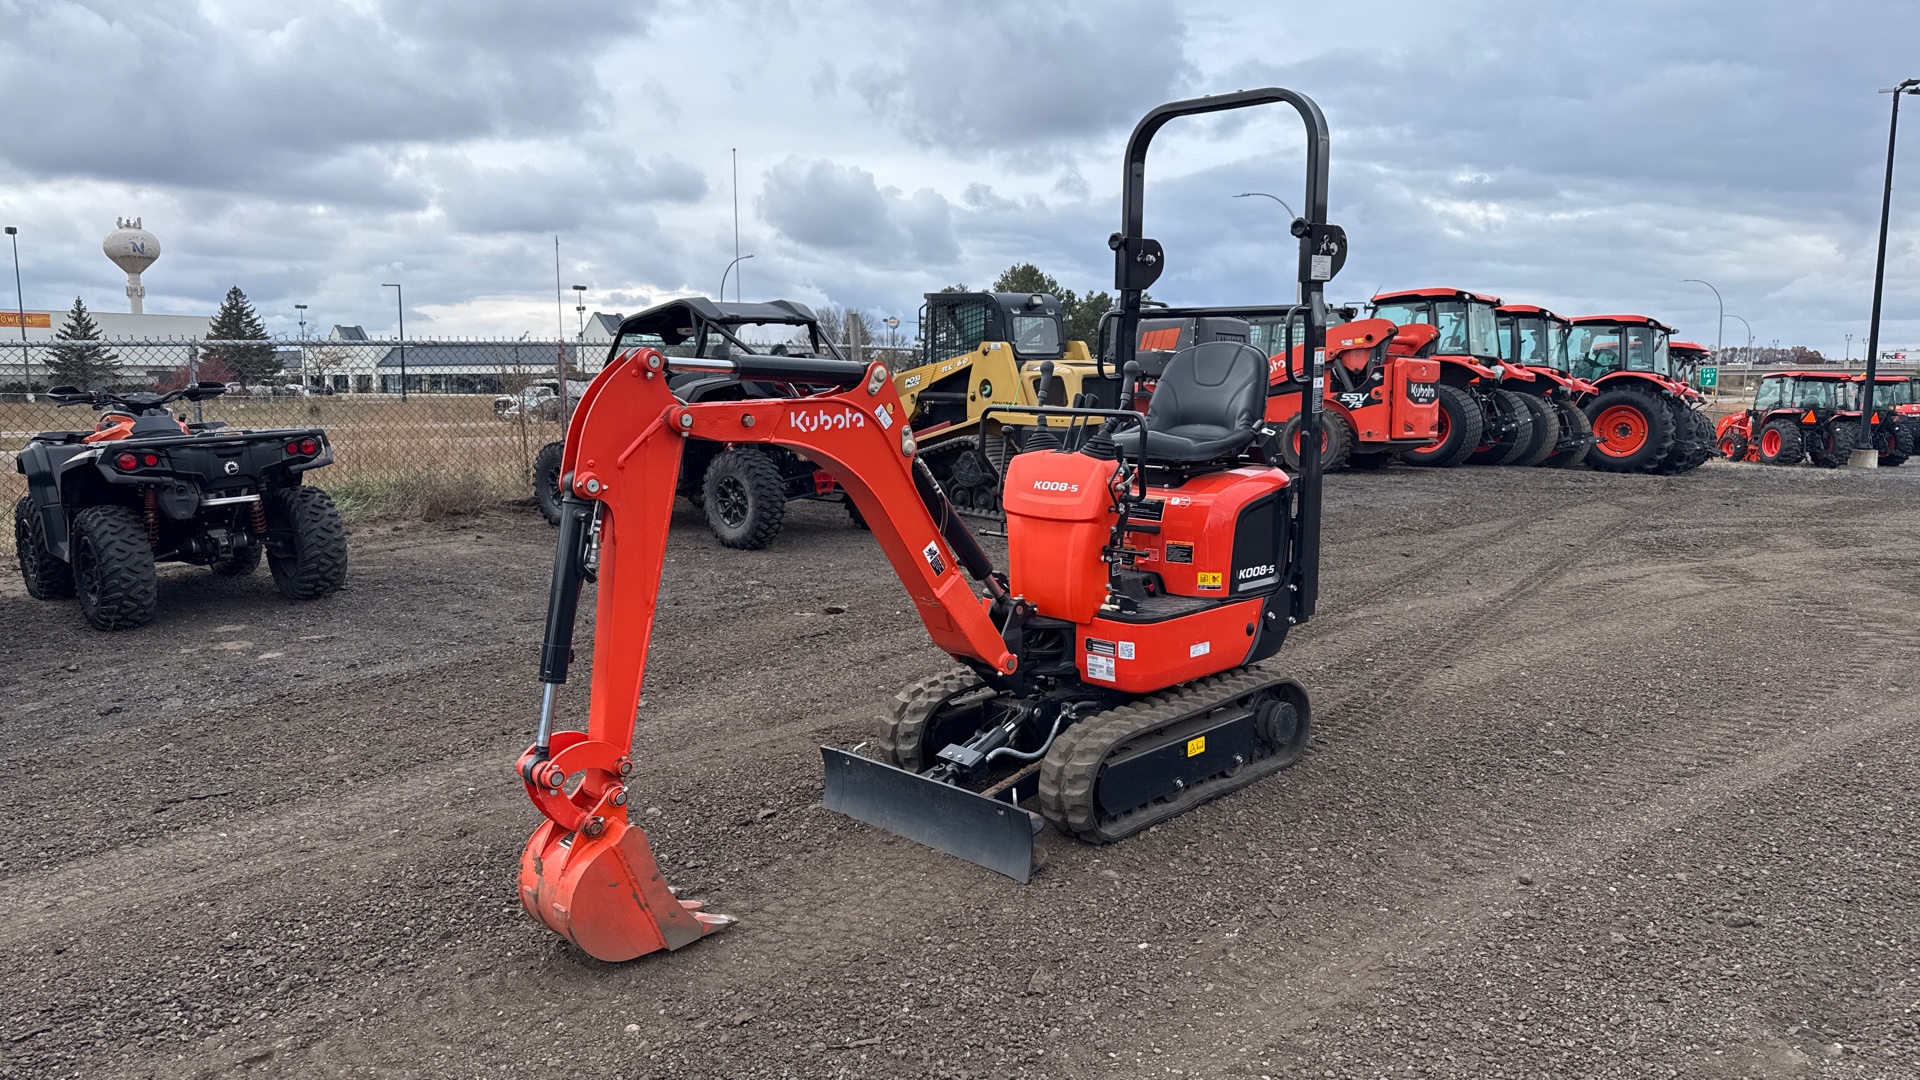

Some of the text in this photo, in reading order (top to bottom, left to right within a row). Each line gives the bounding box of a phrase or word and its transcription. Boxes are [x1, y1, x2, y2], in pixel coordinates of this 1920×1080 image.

[0, 315, 33, 324] OWEN
[1881, 352, 1906, 360] FedEx
[941, 357, 969, 373] RC-60
[905, 374, 921, 385] POSI
[1410, 383, 1435, 398] Kubota
[1340, 392, 1370, 402] SSV
[790, 407, 865, 433] Kubota
[1033, 480, 1079, 492] K008-5
[1238, 564, 1275, 580] K008-5
